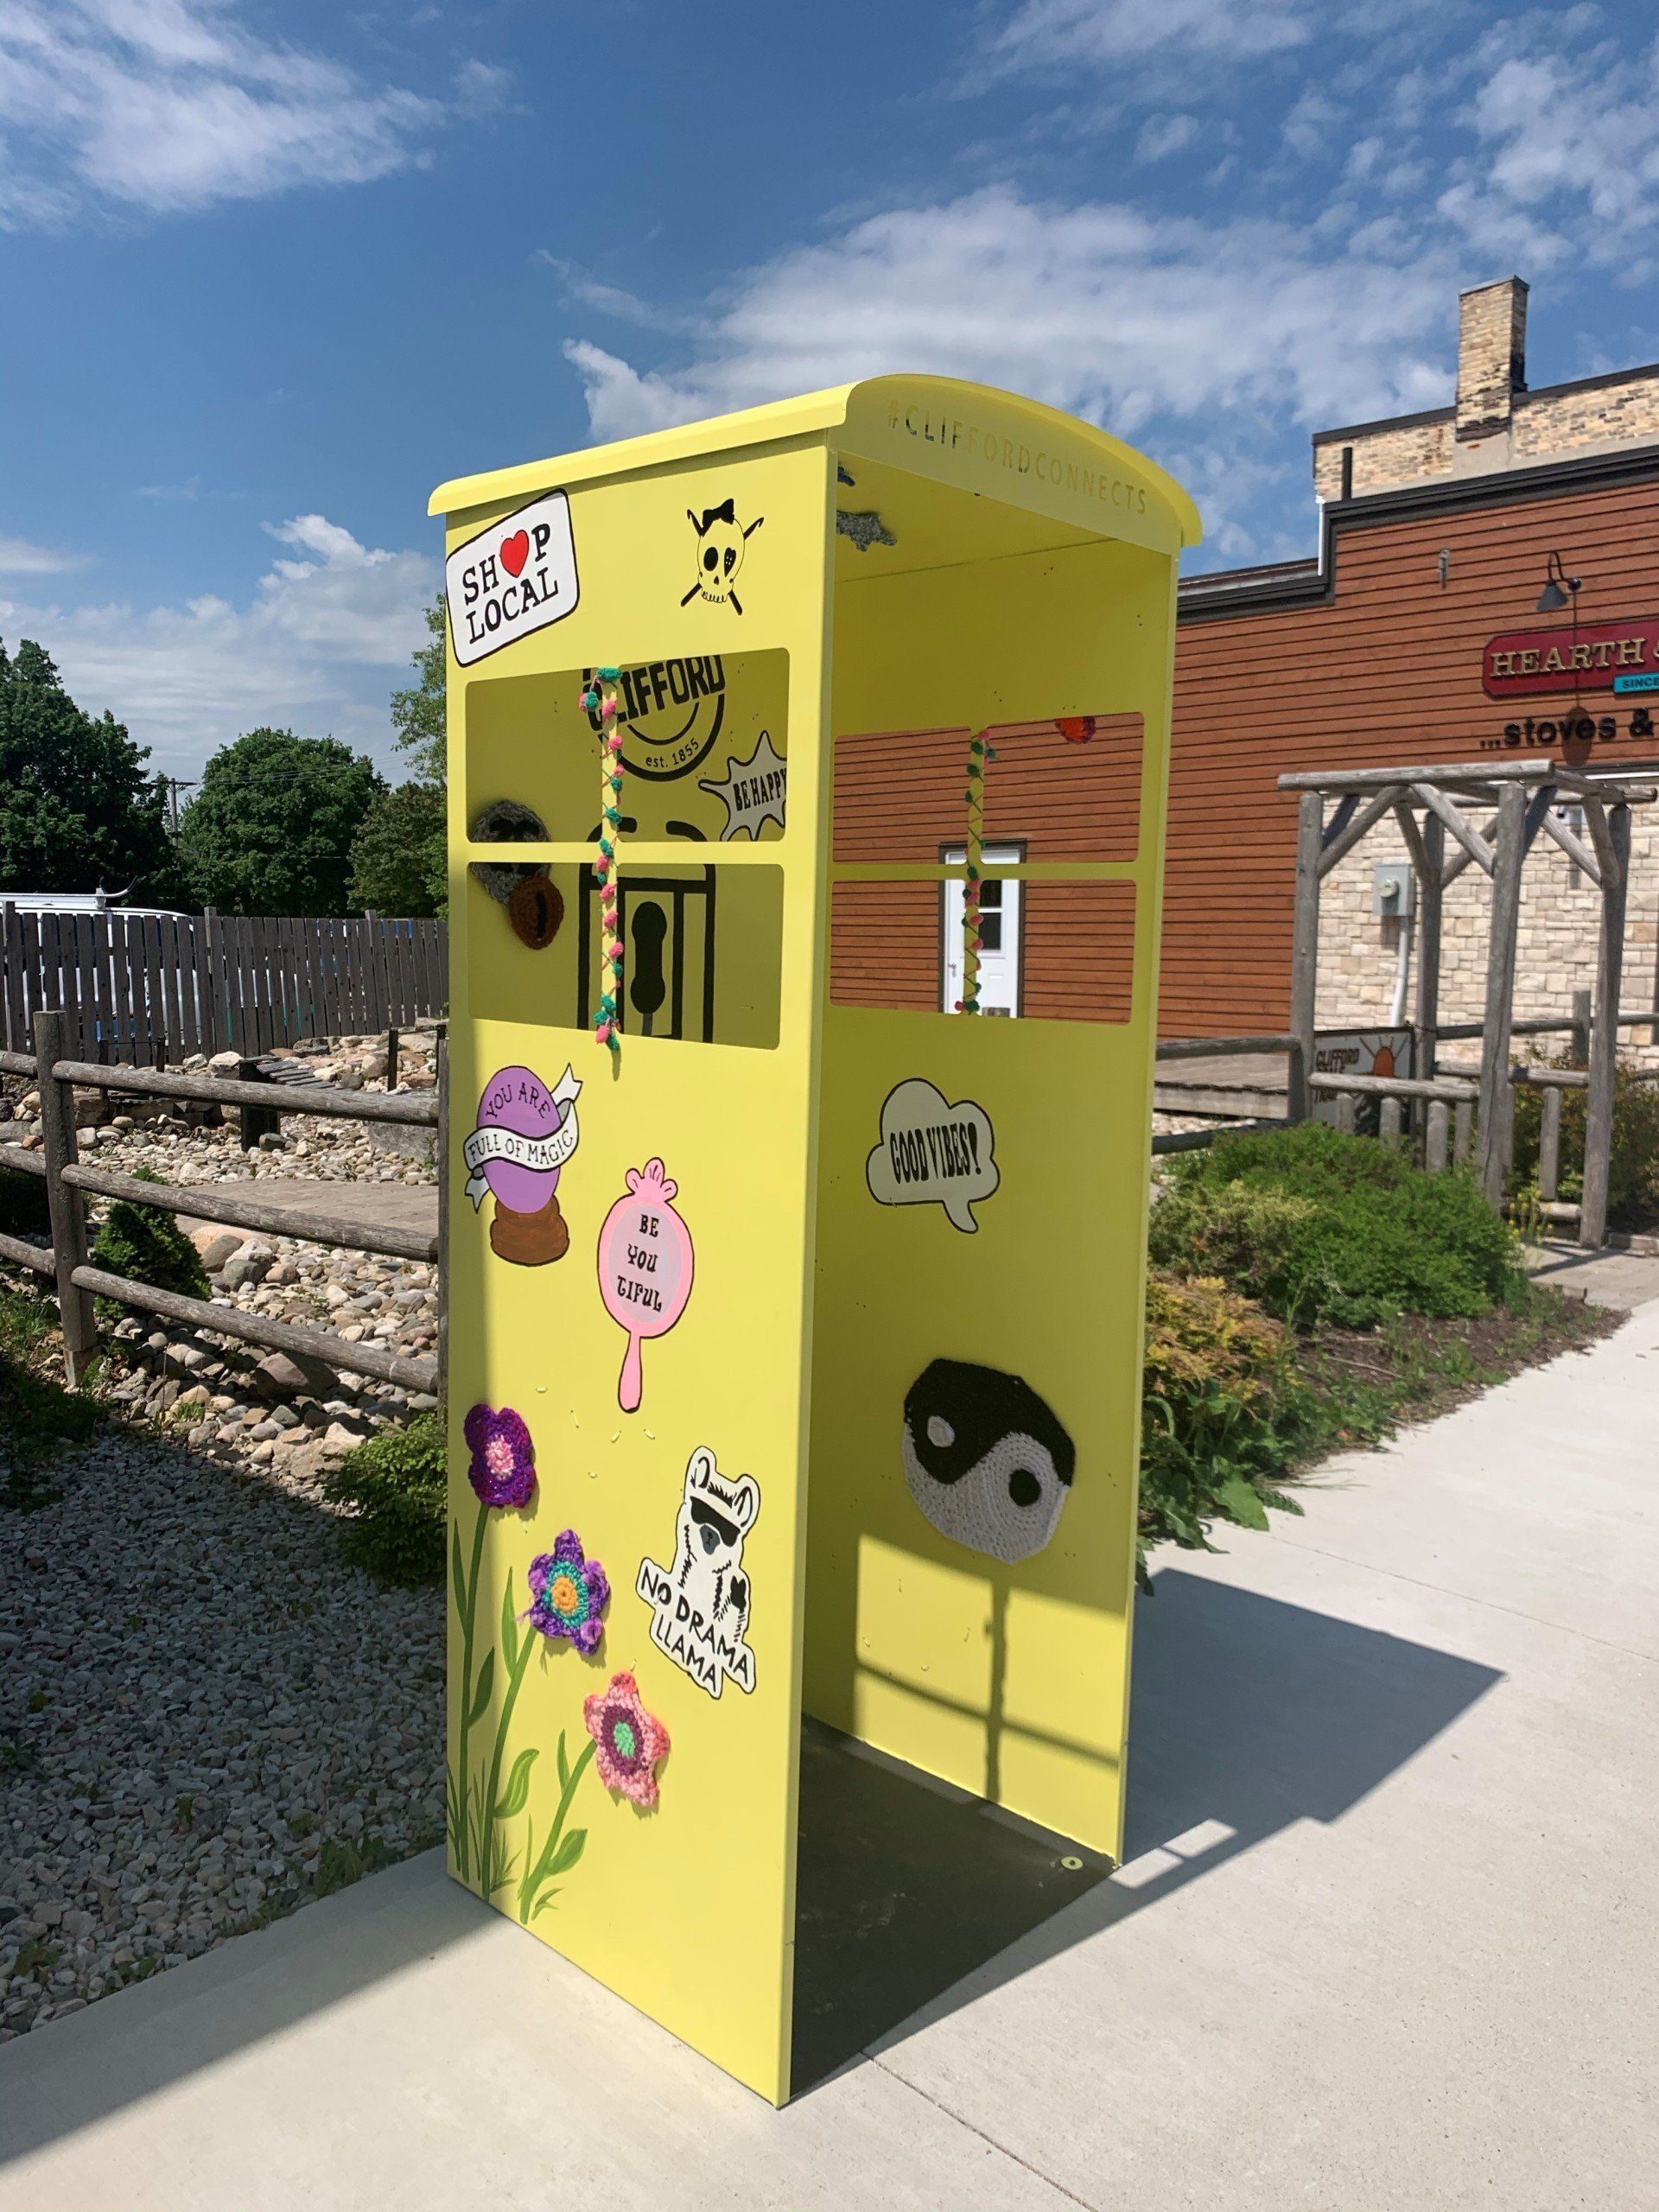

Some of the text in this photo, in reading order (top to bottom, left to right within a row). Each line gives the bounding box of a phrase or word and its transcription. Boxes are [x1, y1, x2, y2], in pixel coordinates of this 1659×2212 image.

[887, 398, 1147, 515] #CLIFFORDCONNECTS
[466, 567, 559, 645] LOCAL
[1489, 637, 1647, 677] HEARTH
[1629, 708, 1655, 738] &
[645, 737, 699, 768] est. 1855
[733, 779, 751, 812] BE
[486, 1082, 550, 1120] YOU ARE
[467, 1129, 573, 1166] FULL OF MAGIC
[889, 1122, 982, 1185] GOOD VIBES!
[639, 1213, 659, 1238] BE
[627, 1243, 658, 1273] YOU
[616, 1274, 662, 1313] TIFUL
[641, 1566, 748, 1685] NO DRAMA
[656, 1613, 716, 1693] LLAMA
